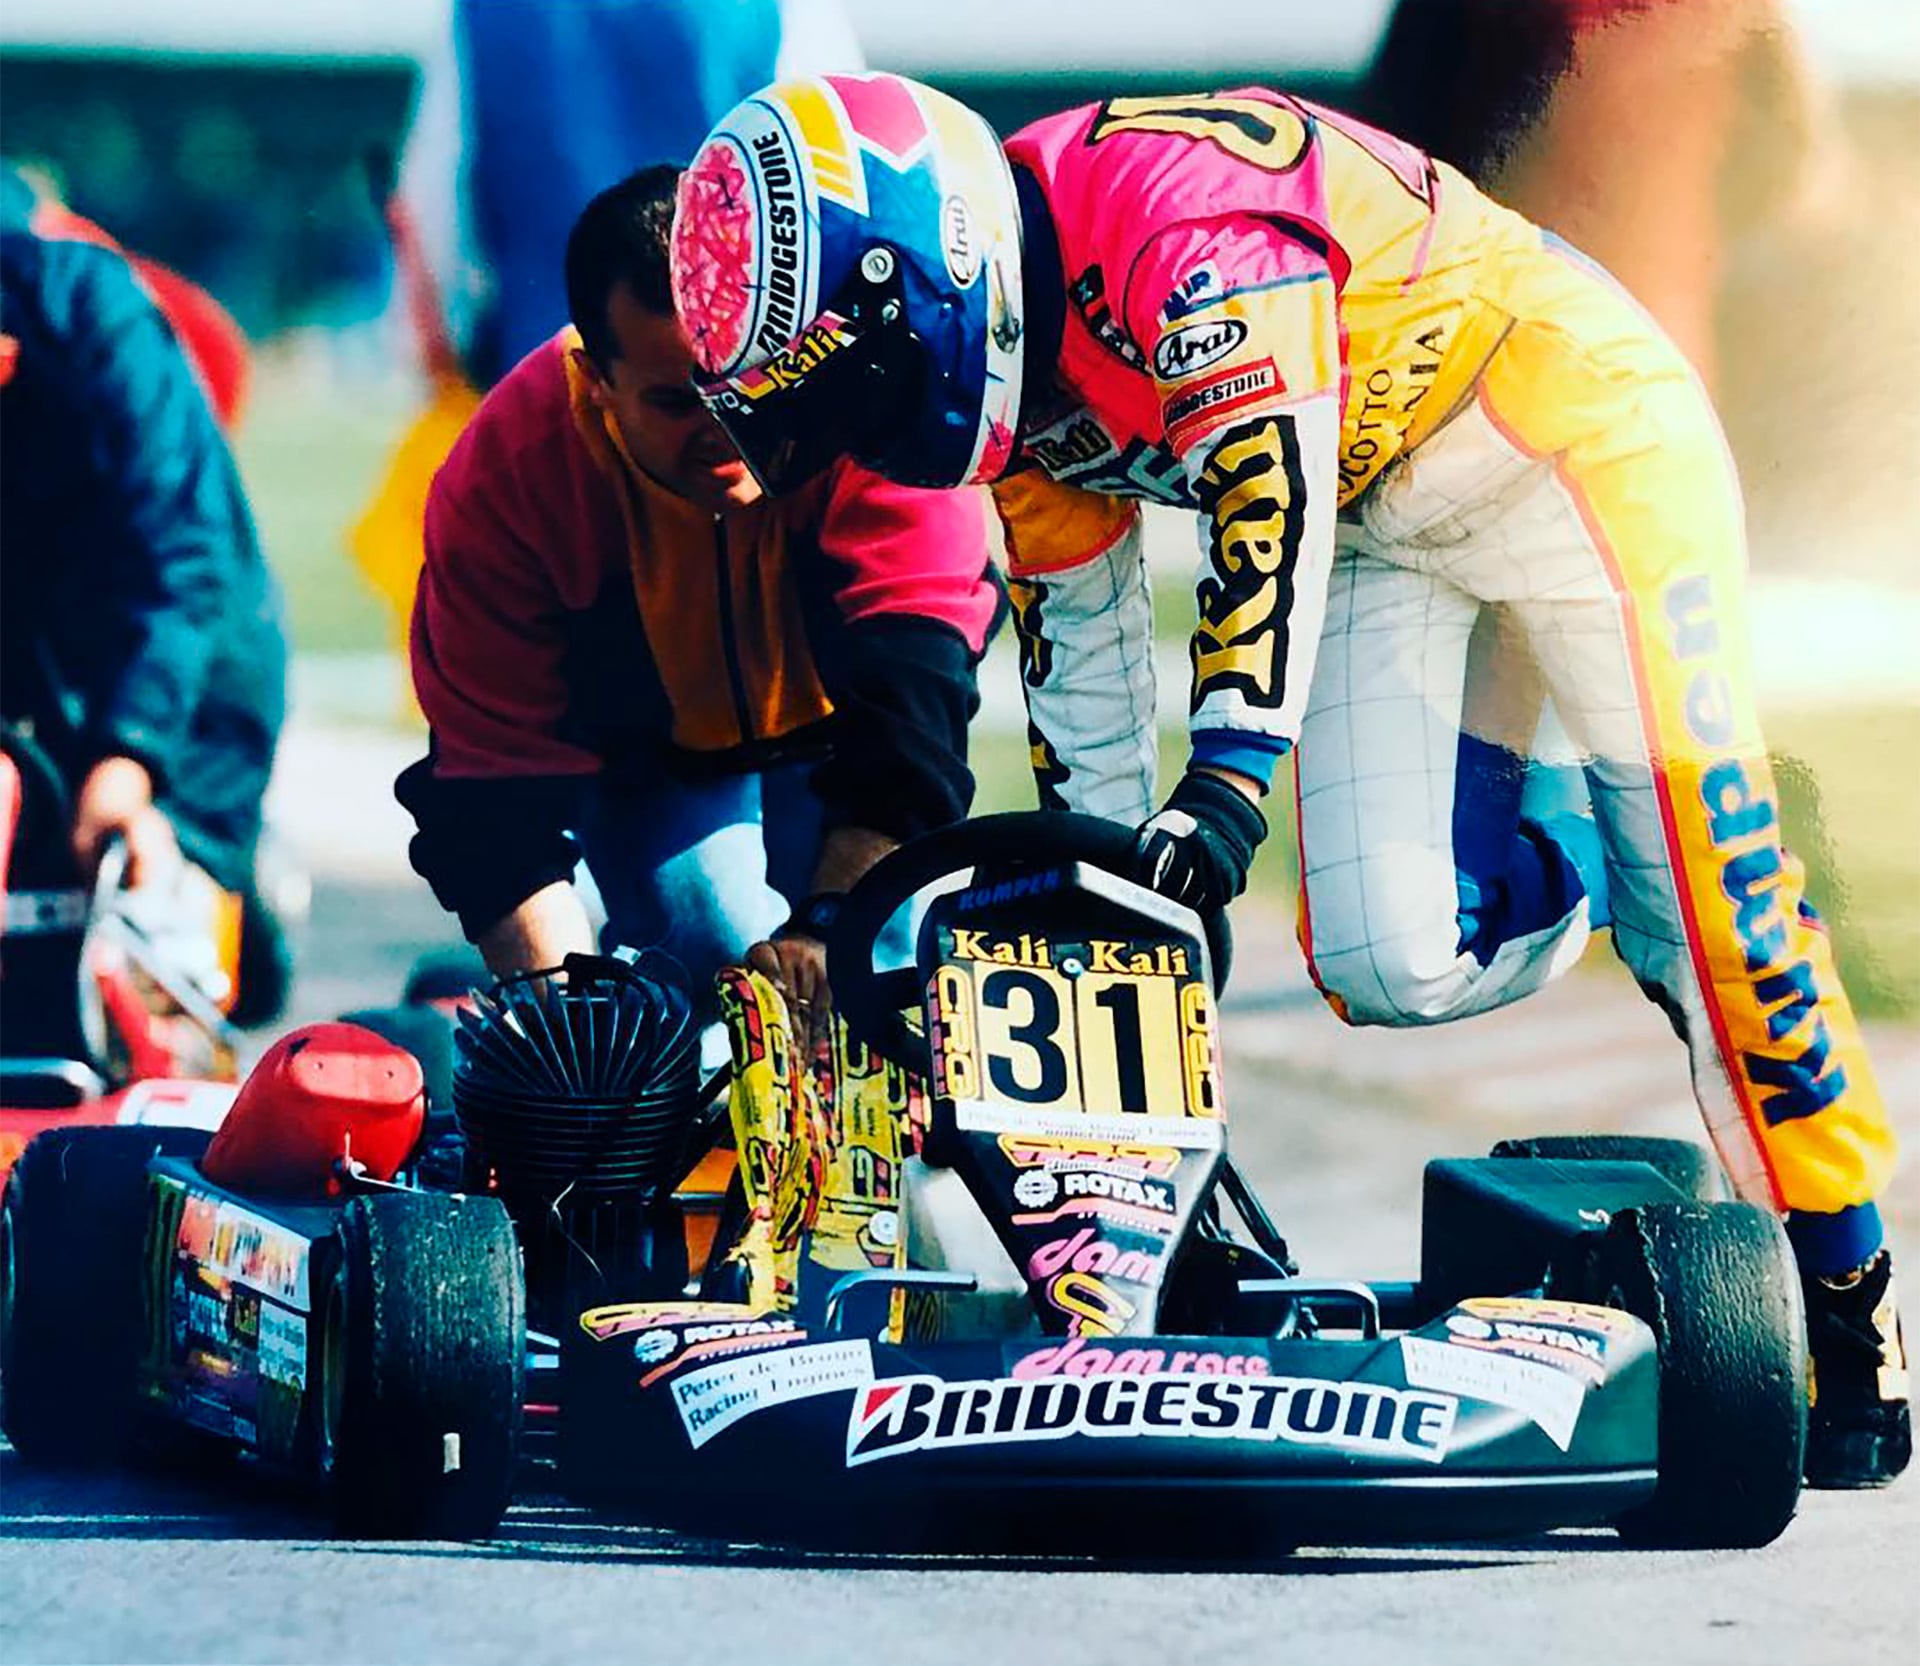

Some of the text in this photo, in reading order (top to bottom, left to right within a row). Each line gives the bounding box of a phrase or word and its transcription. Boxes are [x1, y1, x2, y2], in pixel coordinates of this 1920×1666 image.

[753, 131, 798, 354] BRIDGESTONE
[1160, 322, 1234, 375] Arai
[1194, 418, 1296, 707] Kali
[1663, 574, 1848, 1128] Kumpen
[951, 929, 1189, 977] Kali Kali
[981, 969, 1149, 1114] 31
[1063, 1173, 1168, 1208] ROTAX
[684, 1320, 796, 1344] ROTAX
[850, 1379, 1448, 1458] BRIDGESTONE
